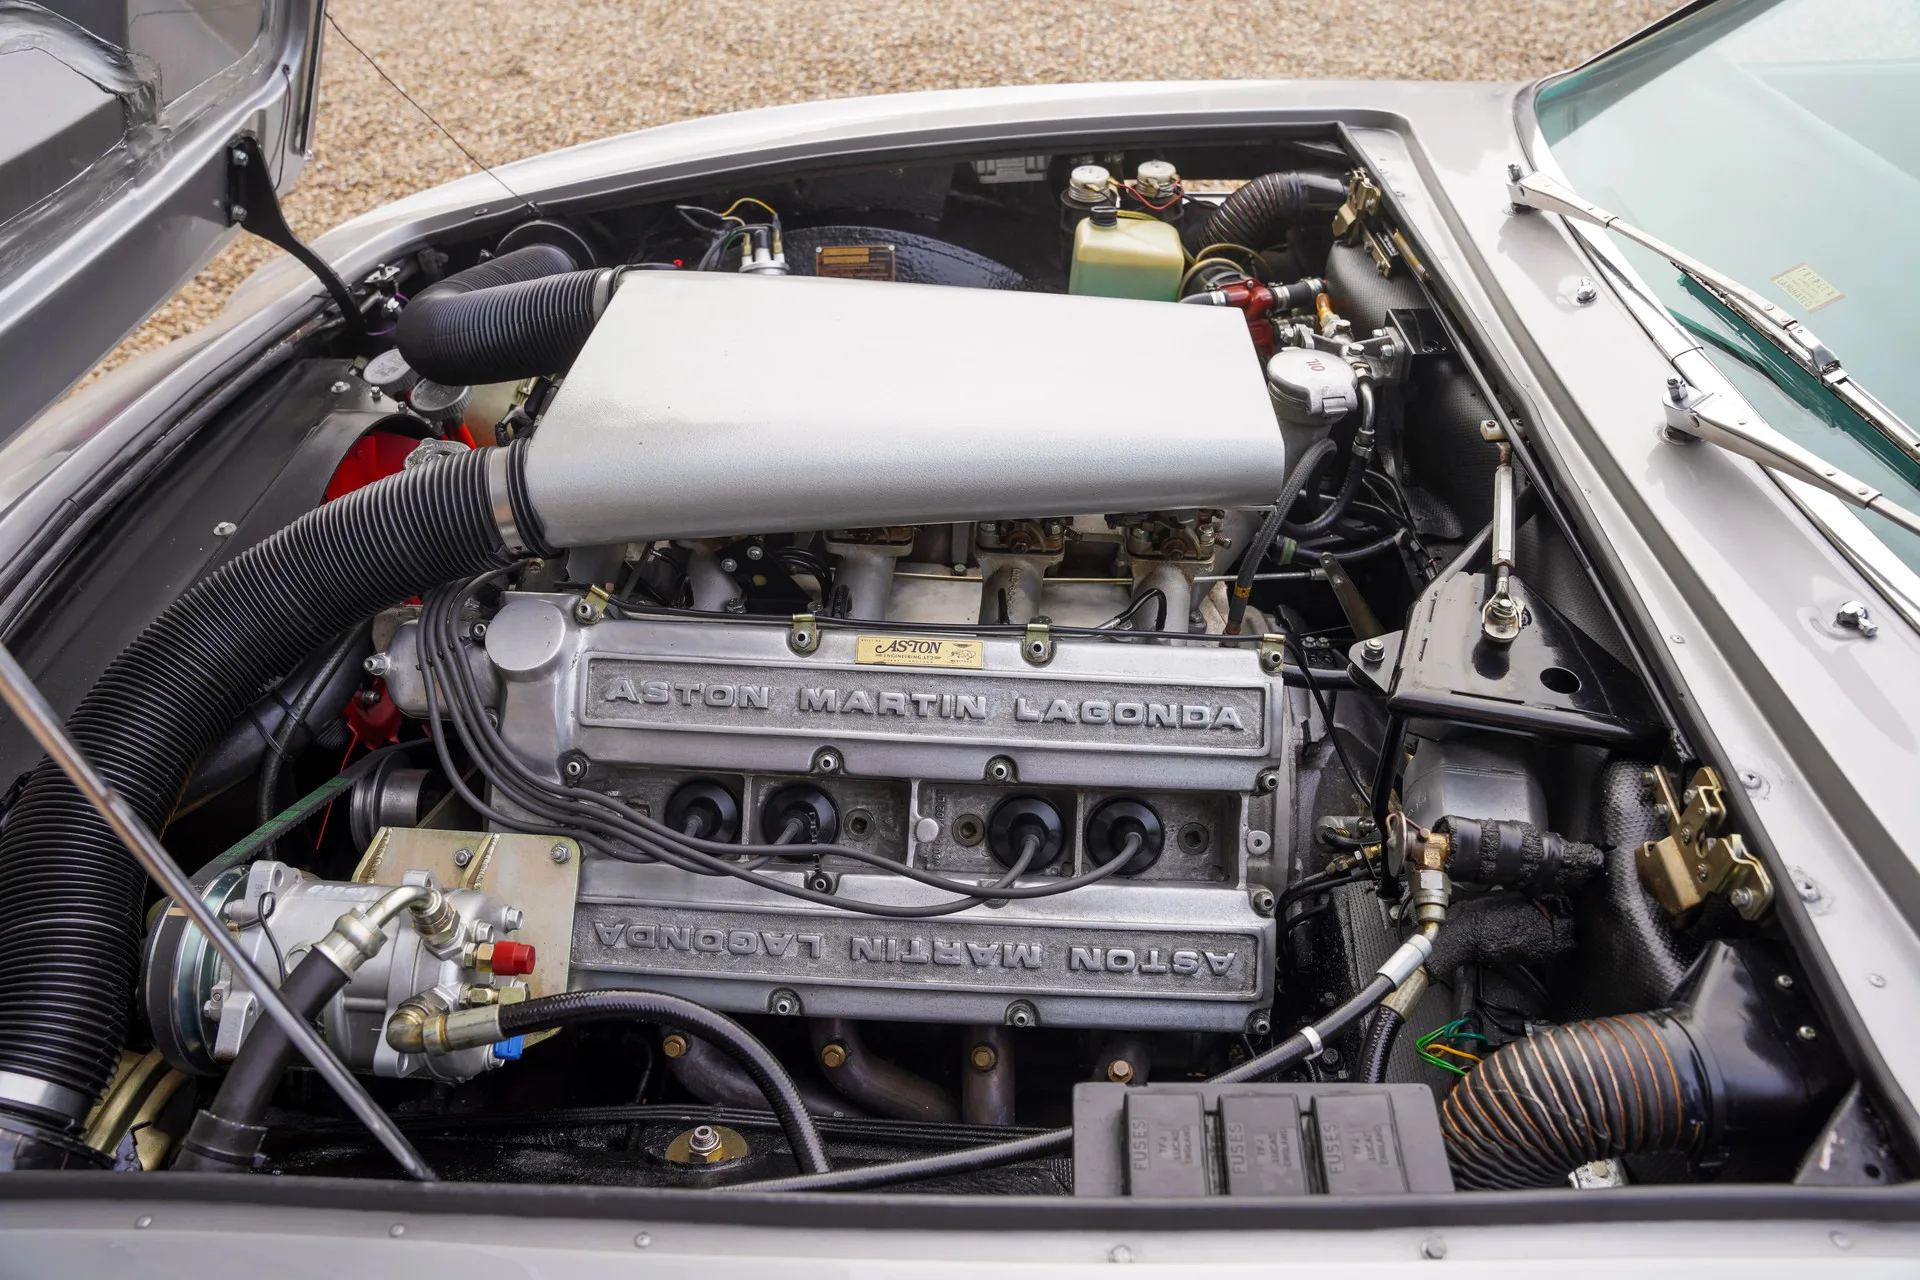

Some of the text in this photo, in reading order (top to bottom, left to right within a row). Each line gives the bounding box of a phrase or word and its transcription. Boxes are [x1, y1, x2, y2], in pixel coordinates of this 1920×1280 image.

[1776, 278, 1813, 307] LAMINATED
[1306, 358, 1326, 371] OIL
[875, 640, 943, 655] ASTON
[604, 676, 1245, 731] ASTON MARTIN LAGONDA
[594, 920, 1238, 978] ASTON MARTIN LAGONDA
[1132, 1120, 1147, 1171] FUSES
[1228, 1123, 1246, 1175] FUSES
[1323, 1123, 1342, 1175] FUSES
